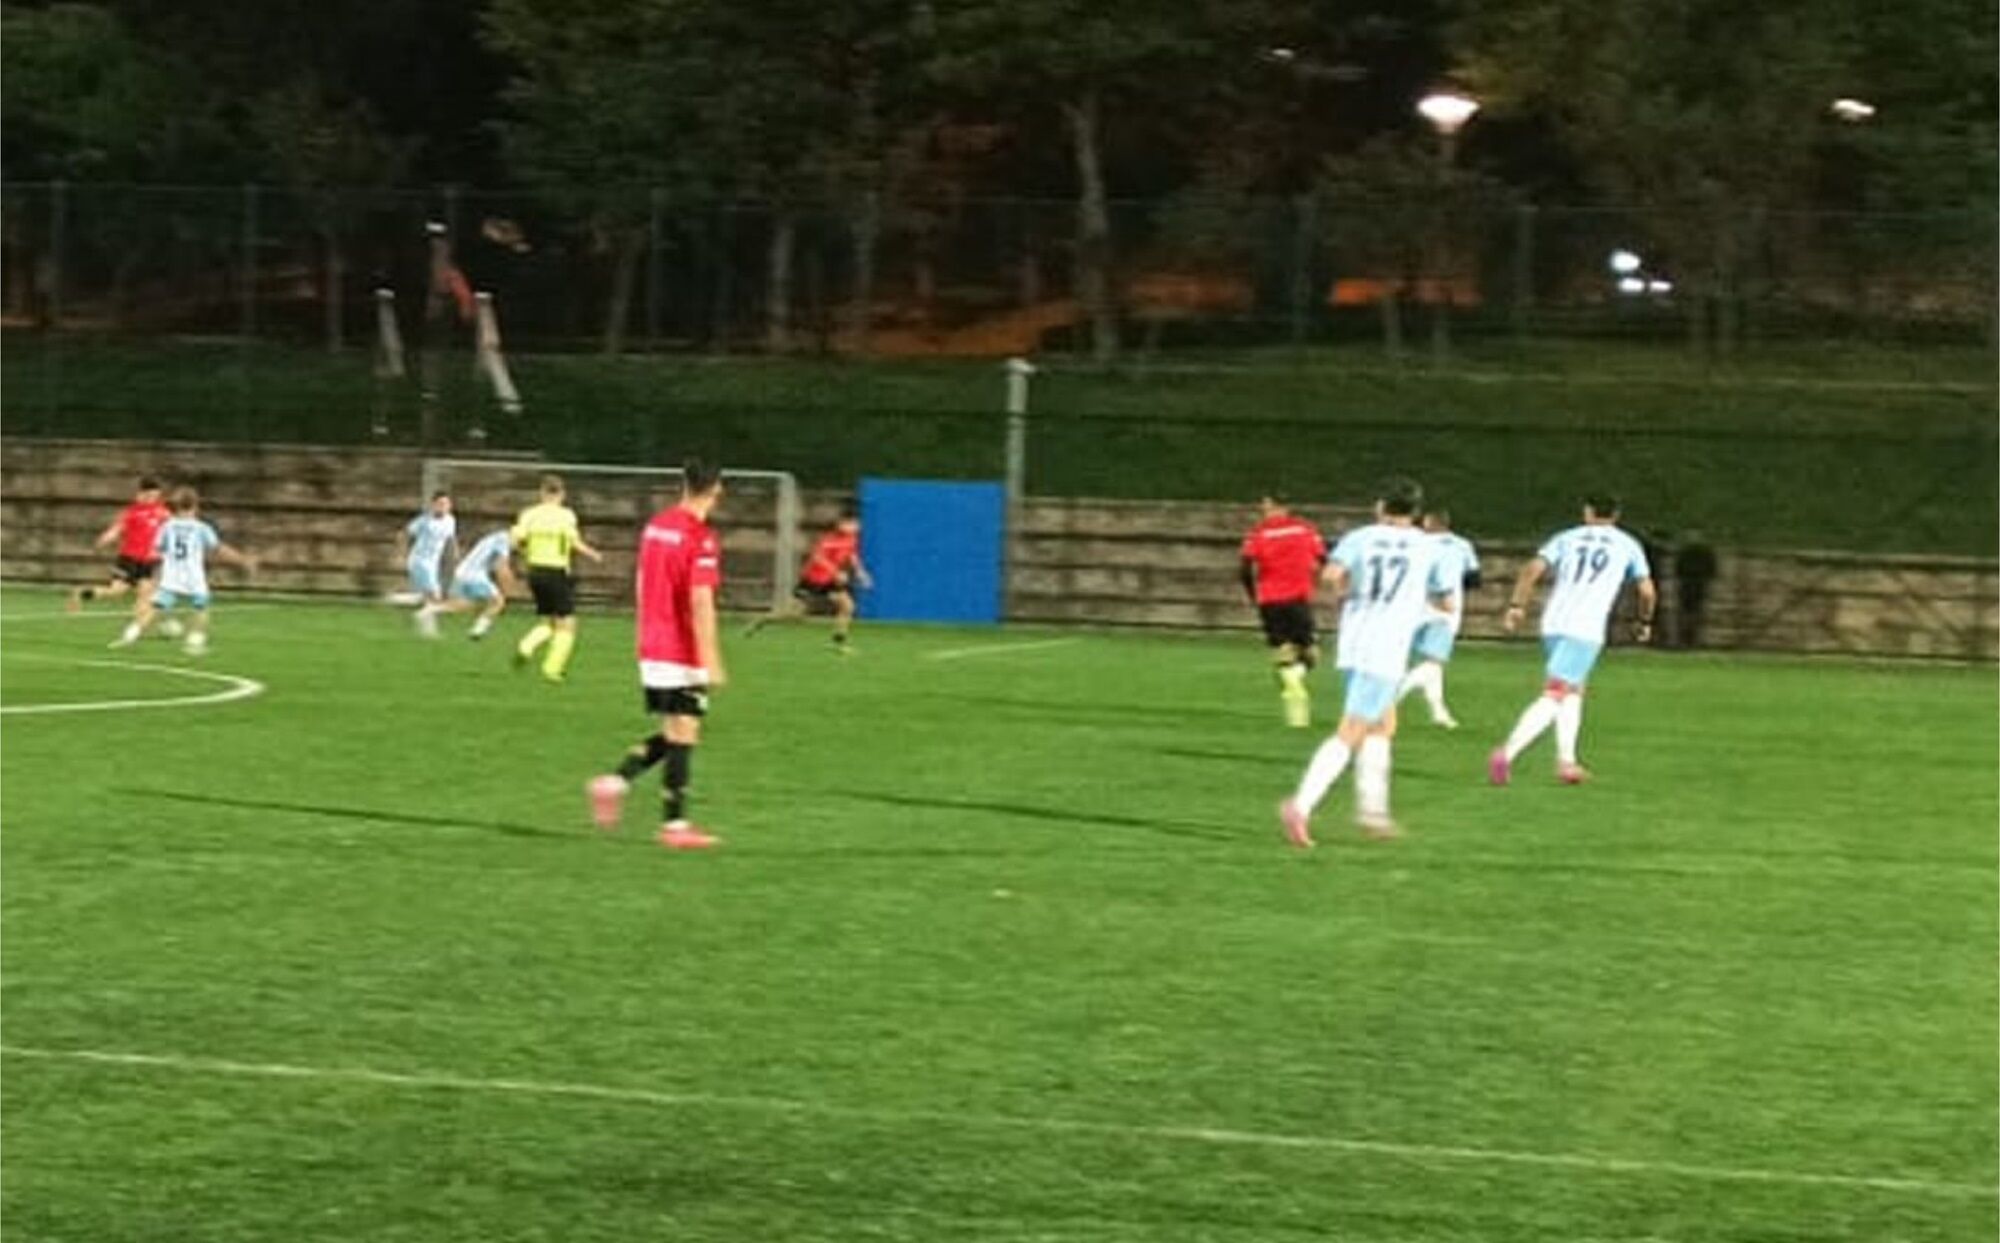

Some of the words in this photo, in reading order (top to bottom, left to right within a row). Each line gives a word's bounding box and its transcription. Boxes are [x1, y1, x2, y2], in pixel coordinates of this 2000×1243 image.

[174, 534, 189, 561] 5
[1573, 546, 1609, 584] 19
[1367, 555, 1409, 604] 17
